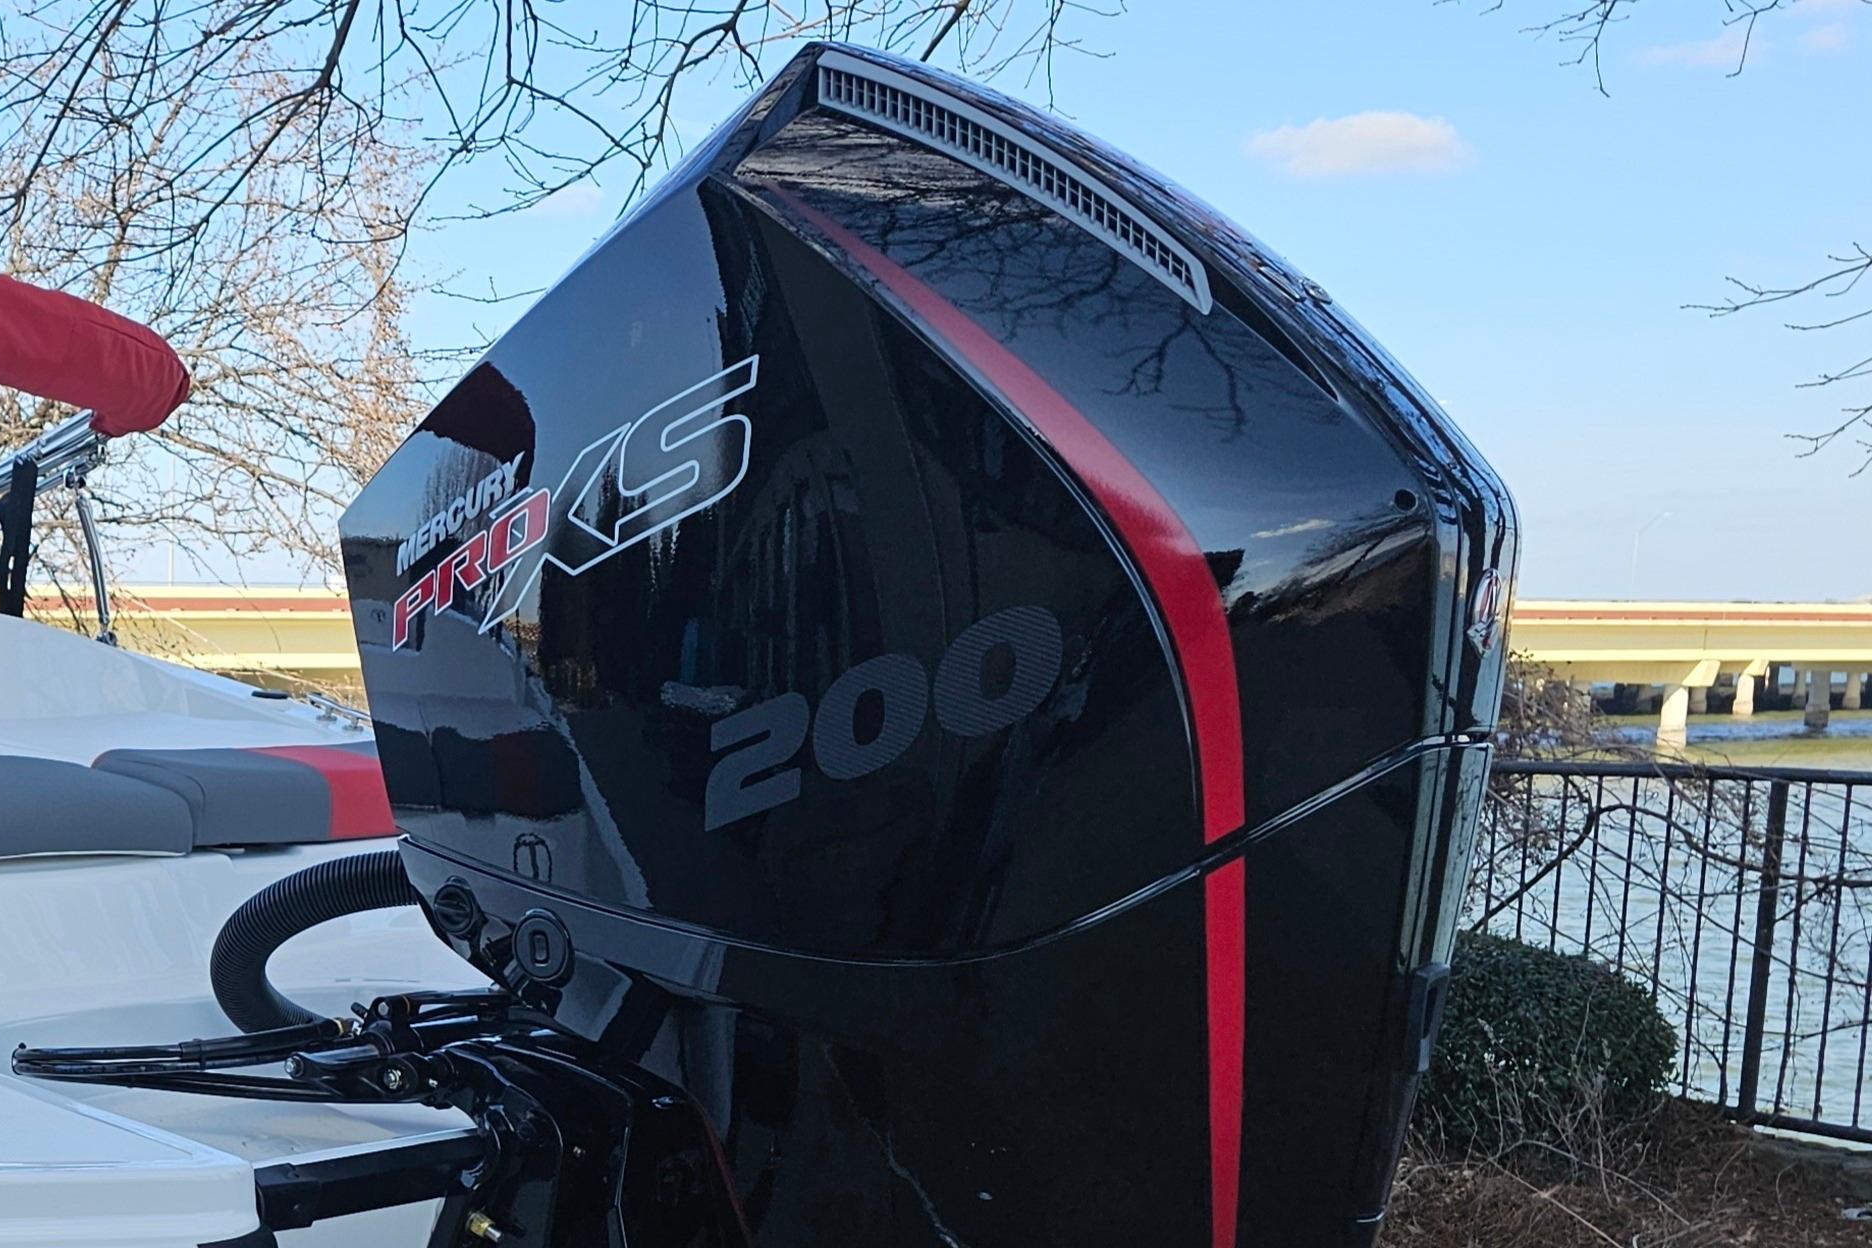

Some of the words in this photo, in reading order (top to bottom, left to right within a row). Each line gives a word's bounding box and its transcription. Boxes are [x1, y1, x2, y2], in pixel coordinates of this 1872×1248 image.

[393, 487, 551, 652] PRO
[397, 451, 525, 577] MERCURY
[705, 605, 1063, 832] 200
